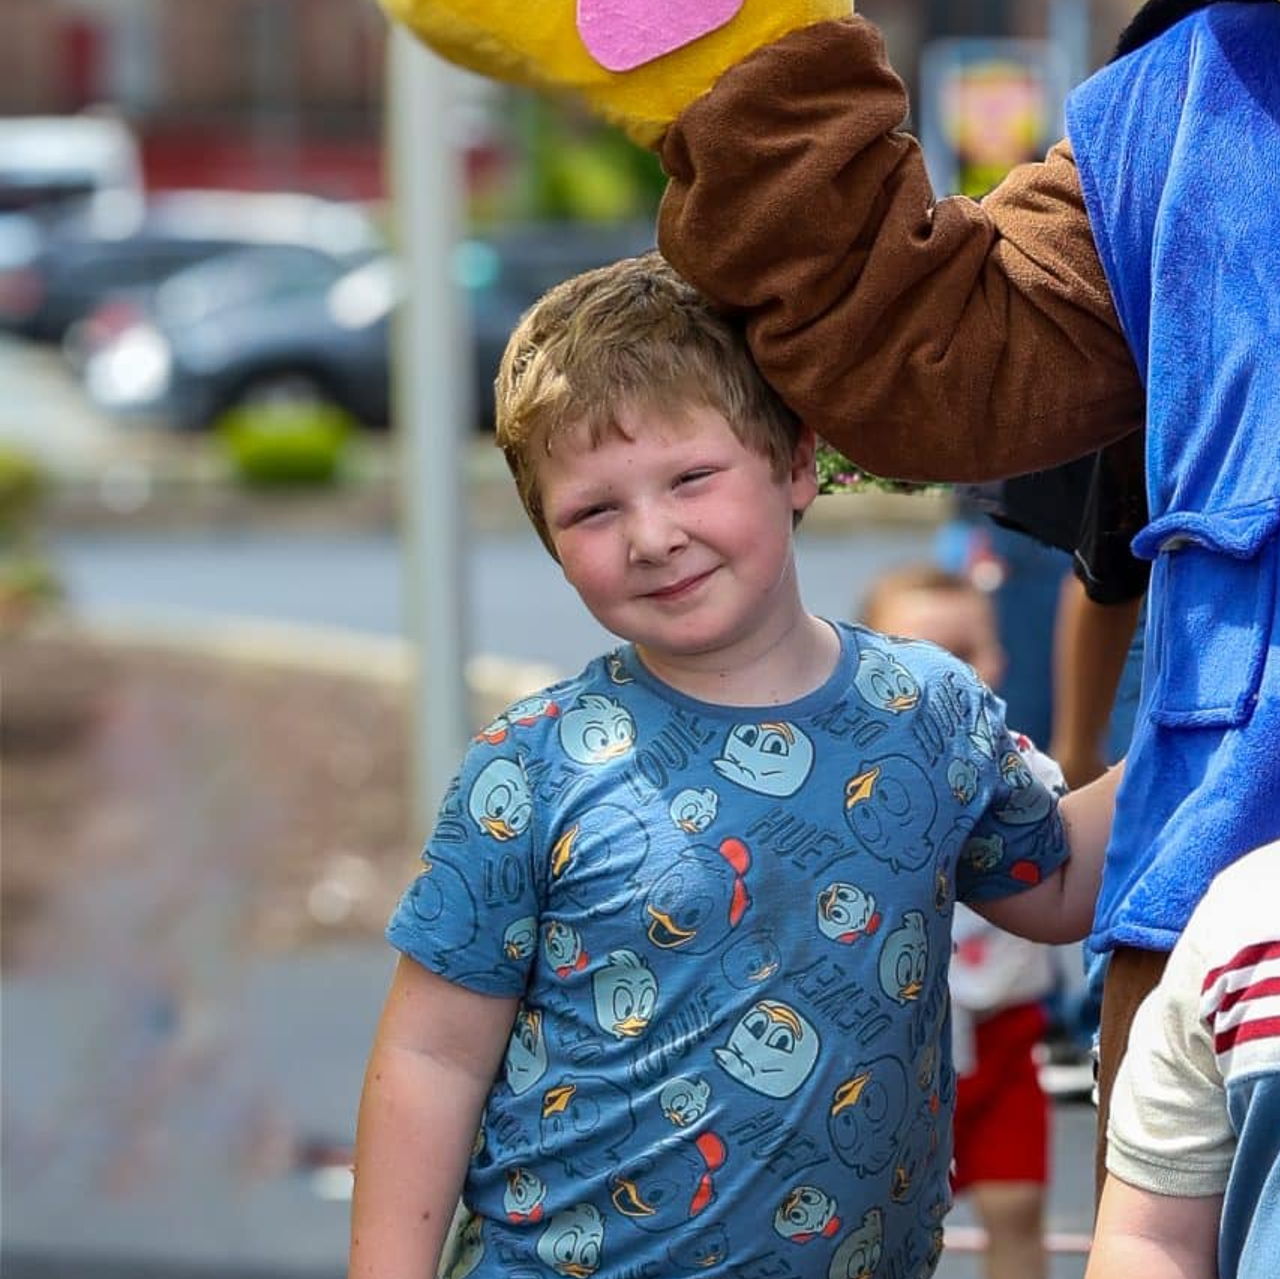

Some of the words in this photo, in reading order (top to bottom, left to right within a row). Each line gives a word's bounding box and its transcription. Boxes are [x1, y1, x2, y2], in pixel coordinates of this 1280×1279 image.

[618, 707, 717, 808] LOUIE
[745, 806, 859, 878] HUEY
[783, 953, 894, 1047] DEWEY
[727, 1109, 830, 1182] HUEY
